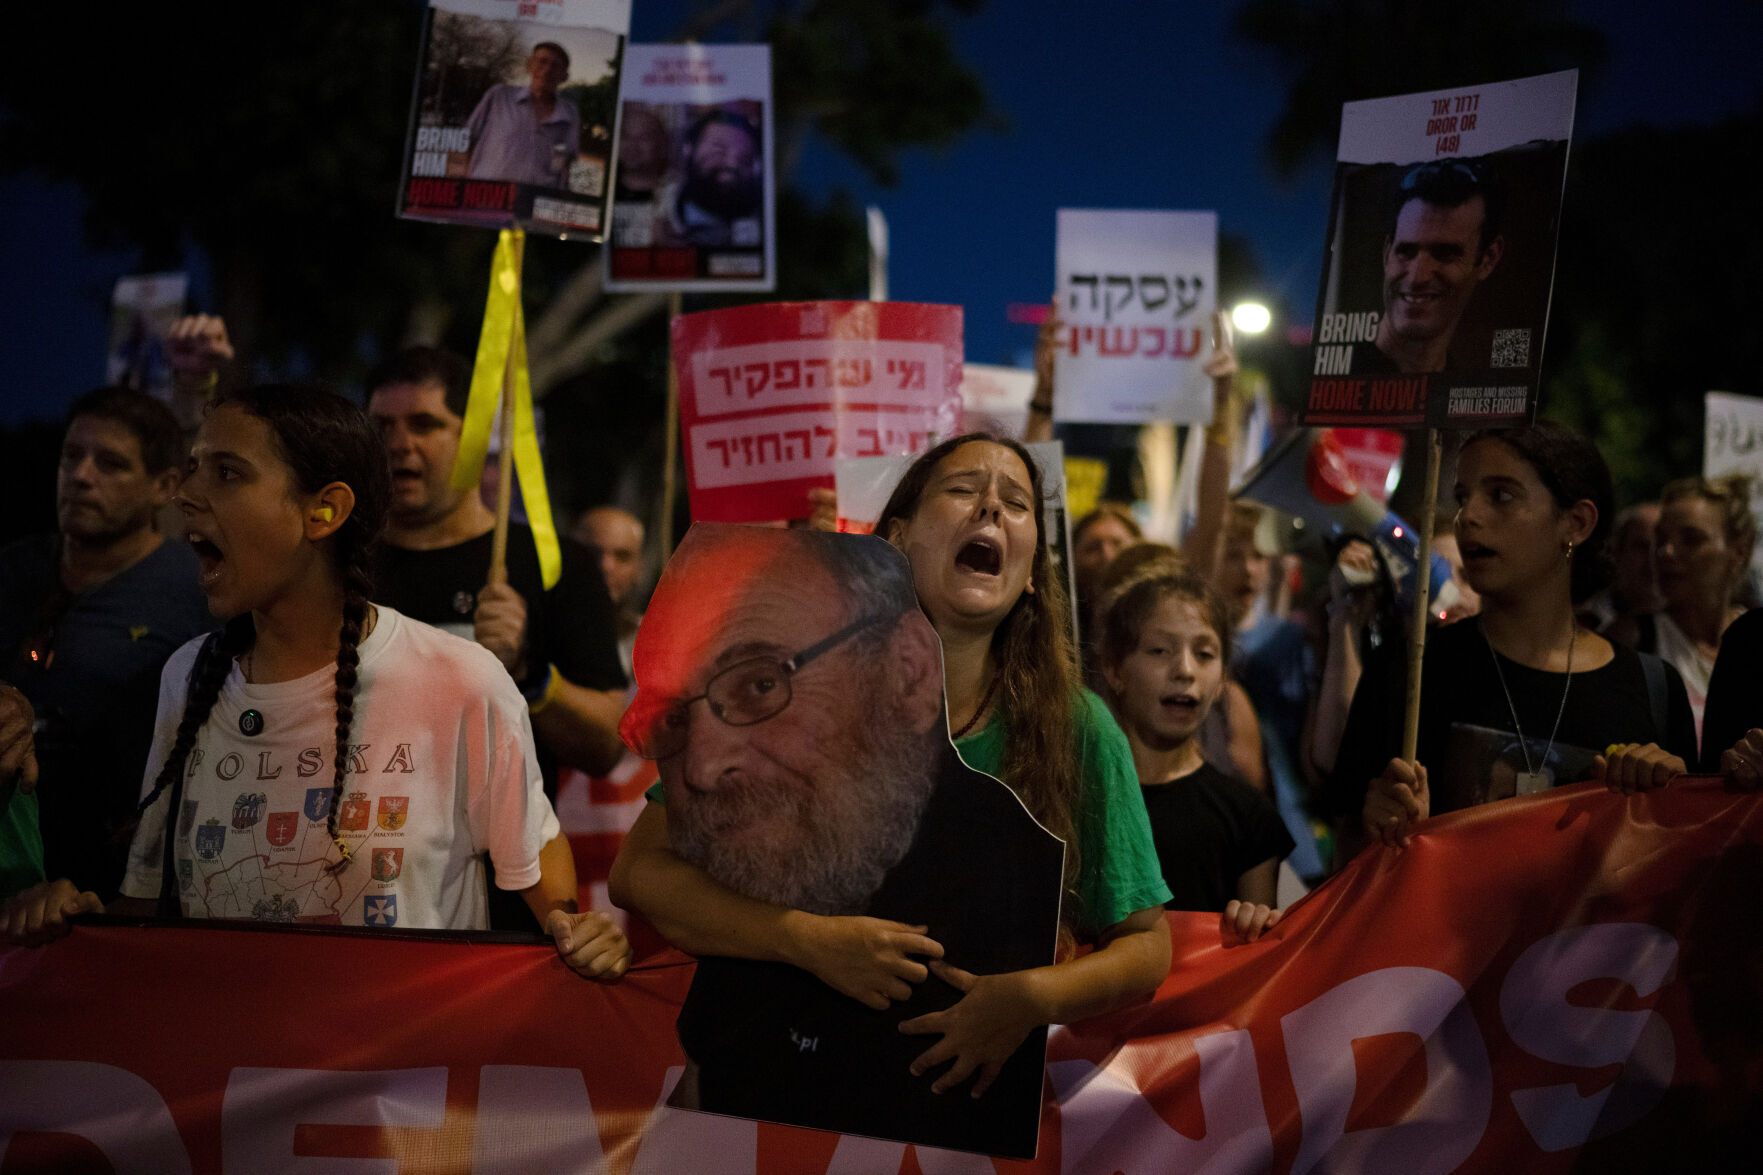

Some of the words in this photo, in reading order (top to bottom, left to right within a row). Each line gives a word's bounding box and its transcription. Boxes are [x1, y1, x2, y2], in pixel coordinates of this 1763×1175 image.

[1432, 98, 1450, 116] אור
[416, 126, 470, 152] BRING
[1426, 116, 1457, 136] DROR
[1460, 114, 1477, 132] OR
[1436, 134, 1460, 155] (48)
[412, 152, 448, 177] HIM
[1070, 274, 1202, 320] עסקה
[1069, 326, 1202, 359] עכשיו
[1319, 311, 1379, 343] BRING
[887, 360, 925, 391] מי
[1313, 345, 1354, 376] HIM
[1308, 380, 1365, 411] HOME
[1368, 375, 1428, 411] NOW!
[1448, 398, 1490, 414] FAMILIES
[1492, 398, 1528, 414] FORUM
[706, 426, 836, 468] להחזיר
[188, 743, 416, 781] POLSKA
[0, 922, 1678, 1175] EMNDS
